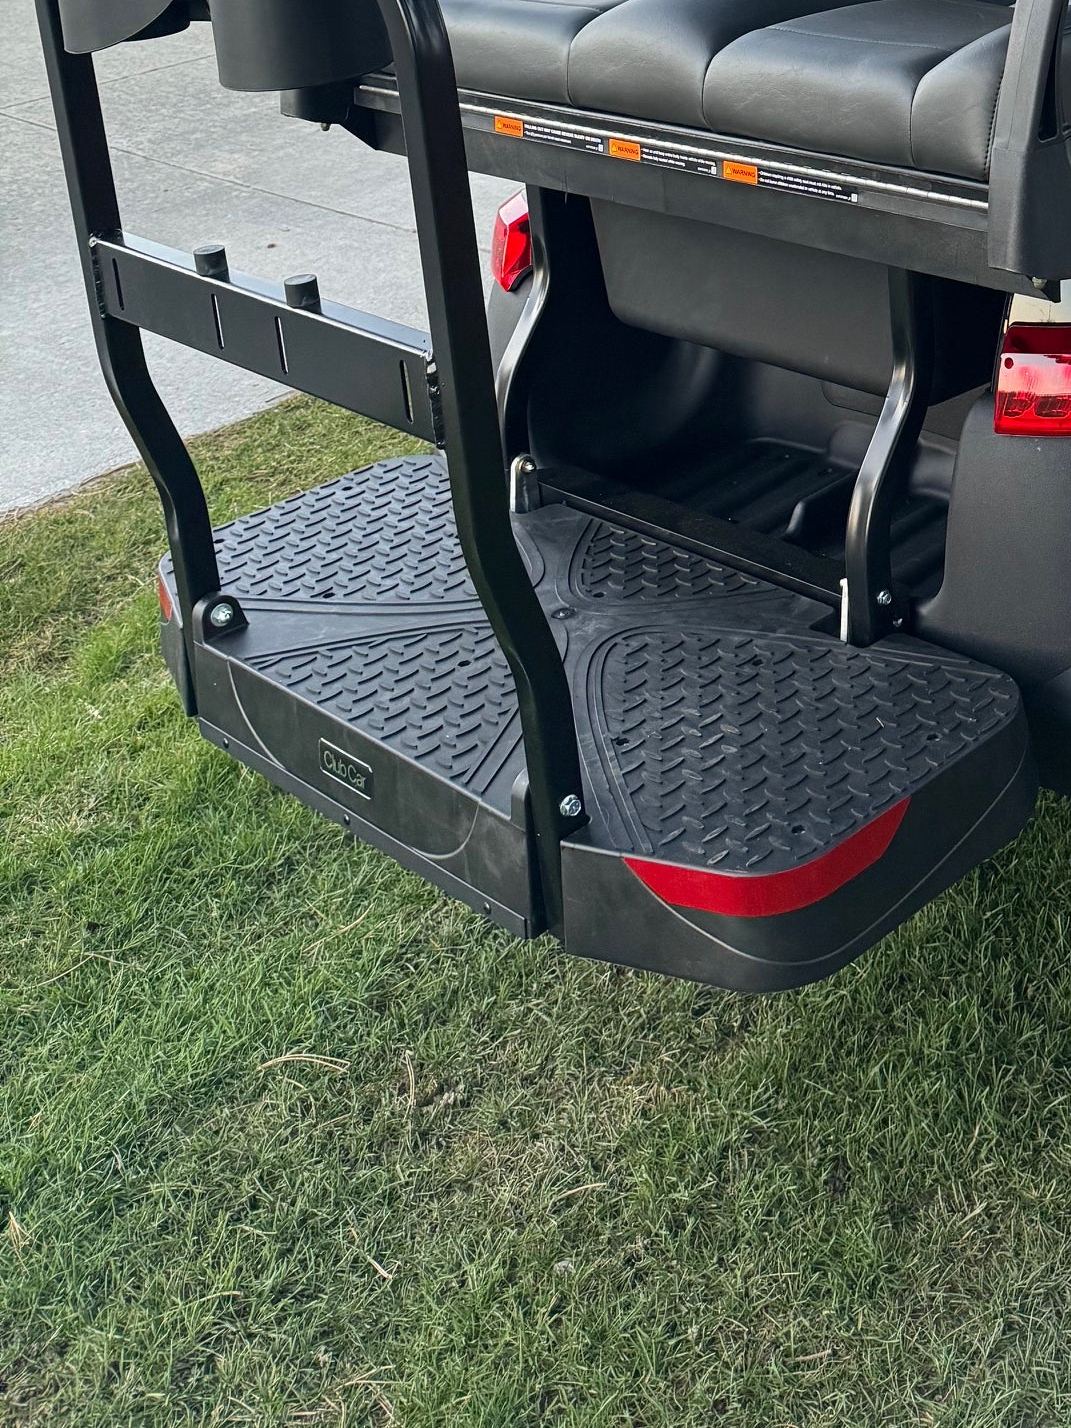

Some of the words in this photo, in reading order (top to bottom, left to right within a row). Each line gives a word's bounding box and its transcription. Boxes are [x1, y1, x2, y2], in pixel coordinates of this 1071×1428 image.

[731, 167, 756, 178] WARNING
[323, 750, 347, 778] Club
[347, 764, 366, 789] Car
